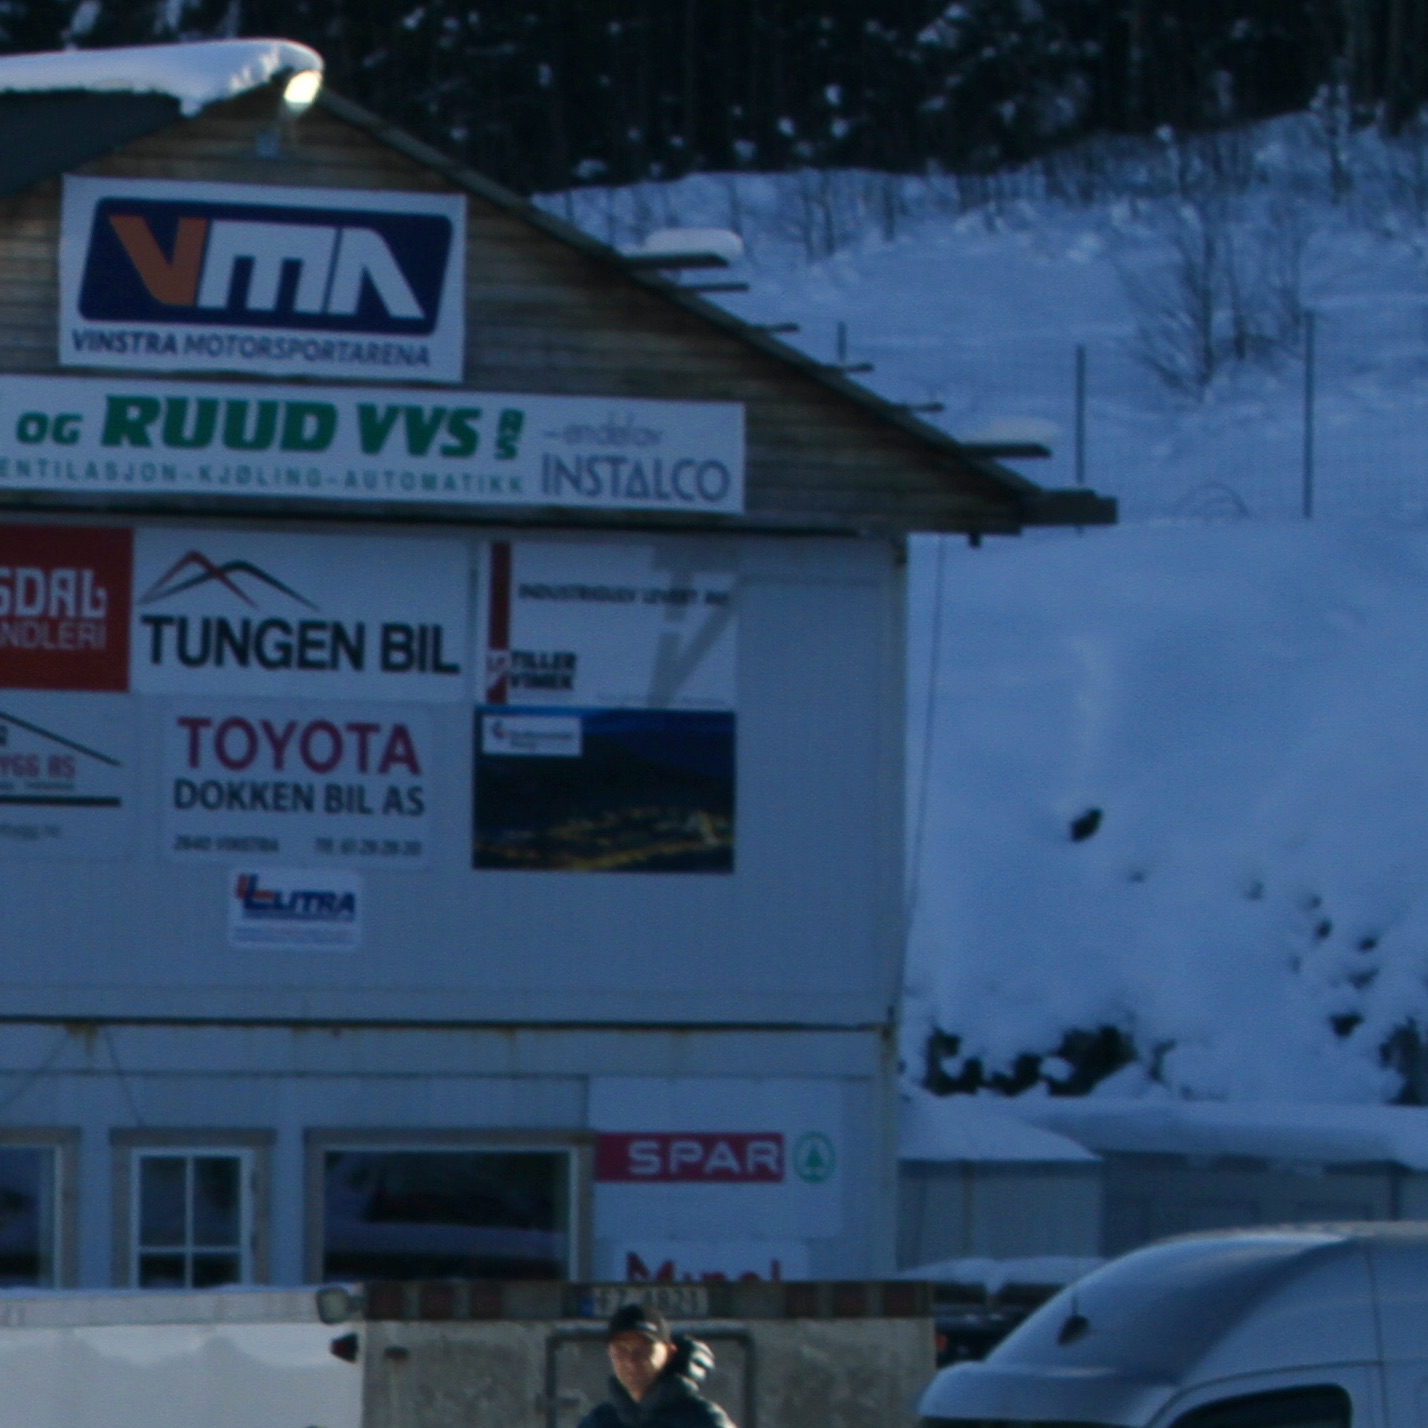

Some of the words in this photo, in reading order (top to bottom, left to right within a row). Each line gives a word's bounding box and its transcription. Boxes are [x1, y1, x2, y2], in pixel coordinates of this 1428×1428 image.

[109, 213, 427, 320] VMA
[71, 328, 177, 355] VINSTRA
[182, 333, 431, 367] MOTORSPORTARENA
[16, 411, 83, 445] OG
[101, 393, 339, 452] RUUD
[356, 402, 483, 459] VVS
[541, 451, 732, 503] INSTALCO
[141, 613, 366, 672] TUNGEN
[380, 621, 461, 675] BIL
[177, 716, 422, 776] TOYOTA
[173, 776, 315, 813] DOKKEN
[323, 782, 374, 815] BIL
[382, 785, 425, 816] AS
[627, 1140, 781, 1177] SPAR
